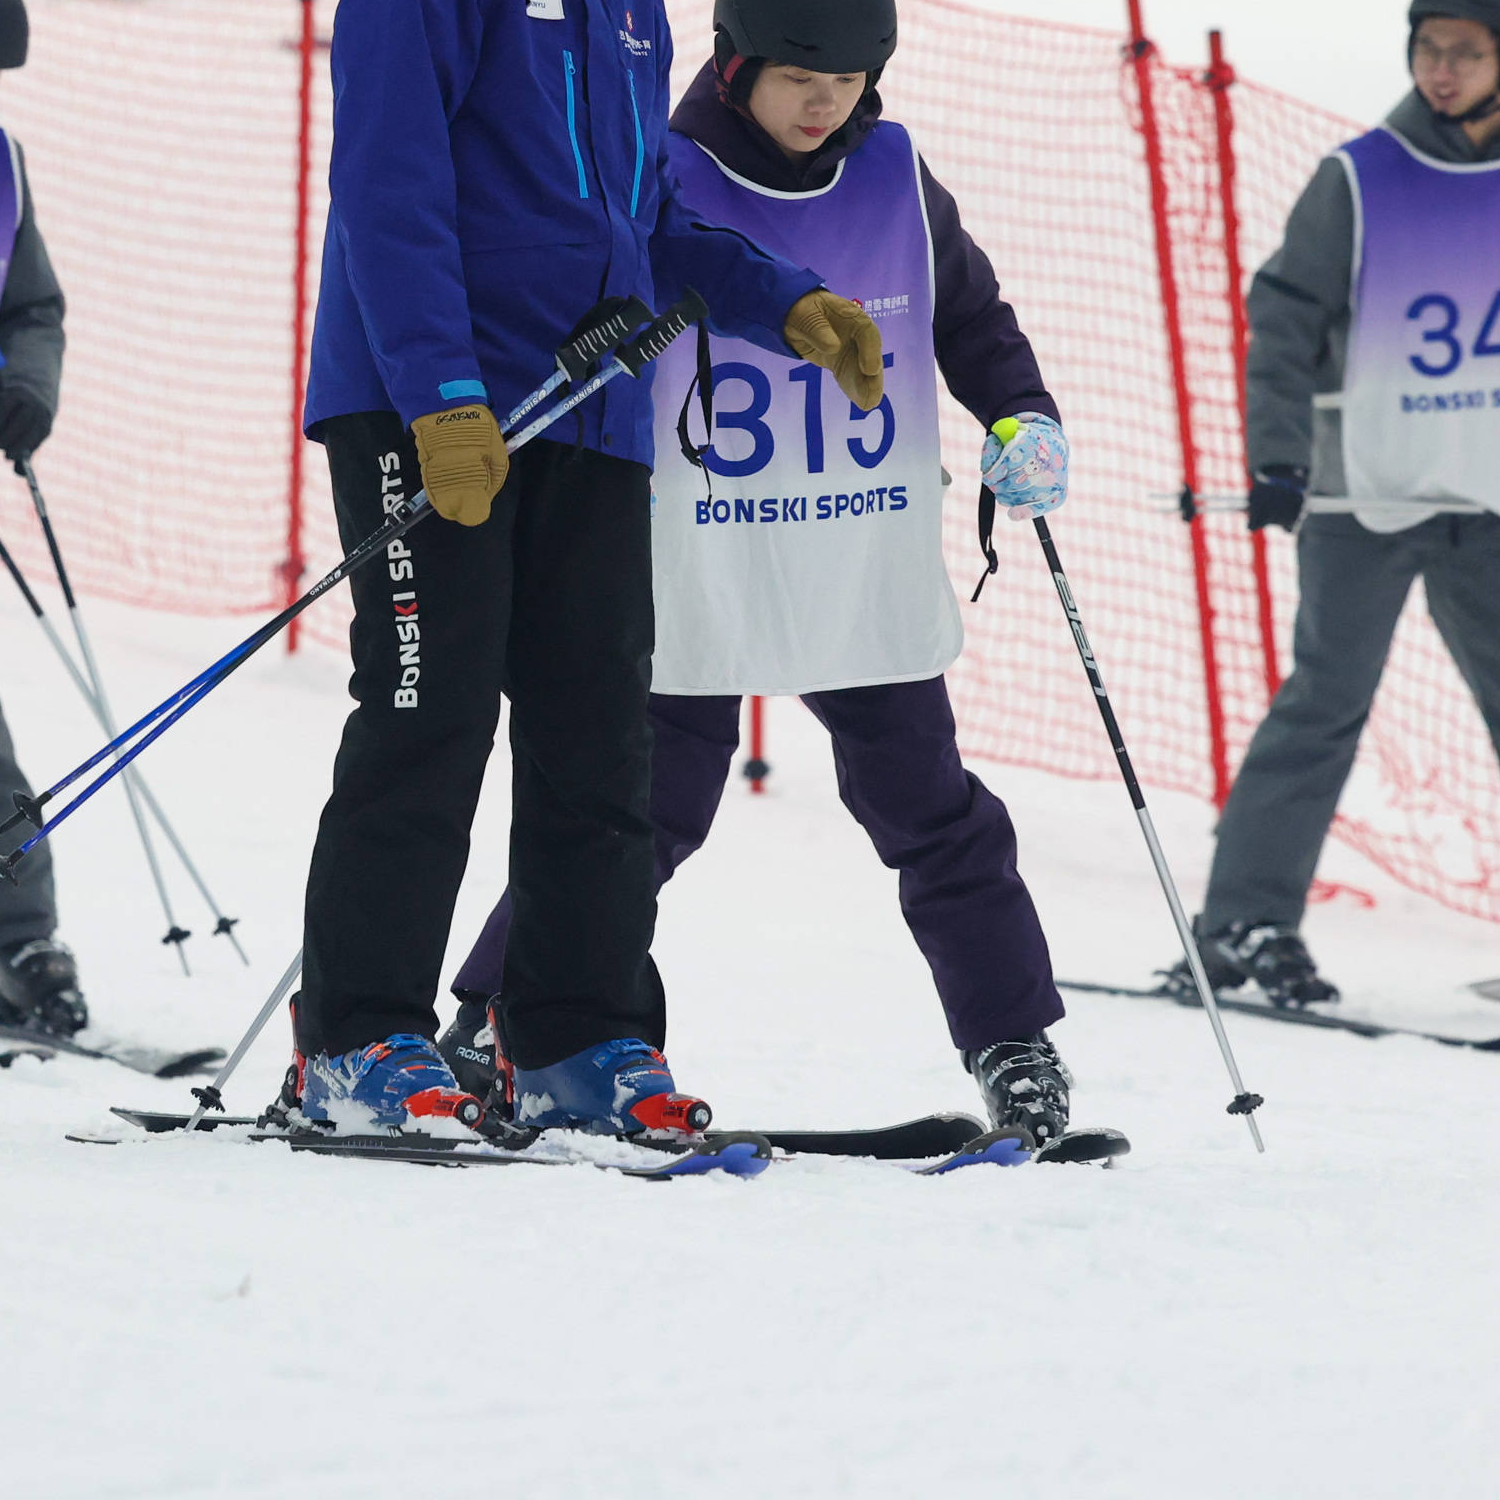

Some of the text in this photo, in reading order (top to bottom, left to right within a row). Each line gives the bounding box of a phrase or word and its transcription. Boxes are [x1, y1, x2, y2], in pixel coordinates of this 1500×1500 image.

[698, 352, 895, 477] 315
[1401, 390, 1485, 412] BONSKI
[696, 486, 908, 525] BONSKI SPORTS
[378, 451, 421, 708] BONSKI SPRTS
